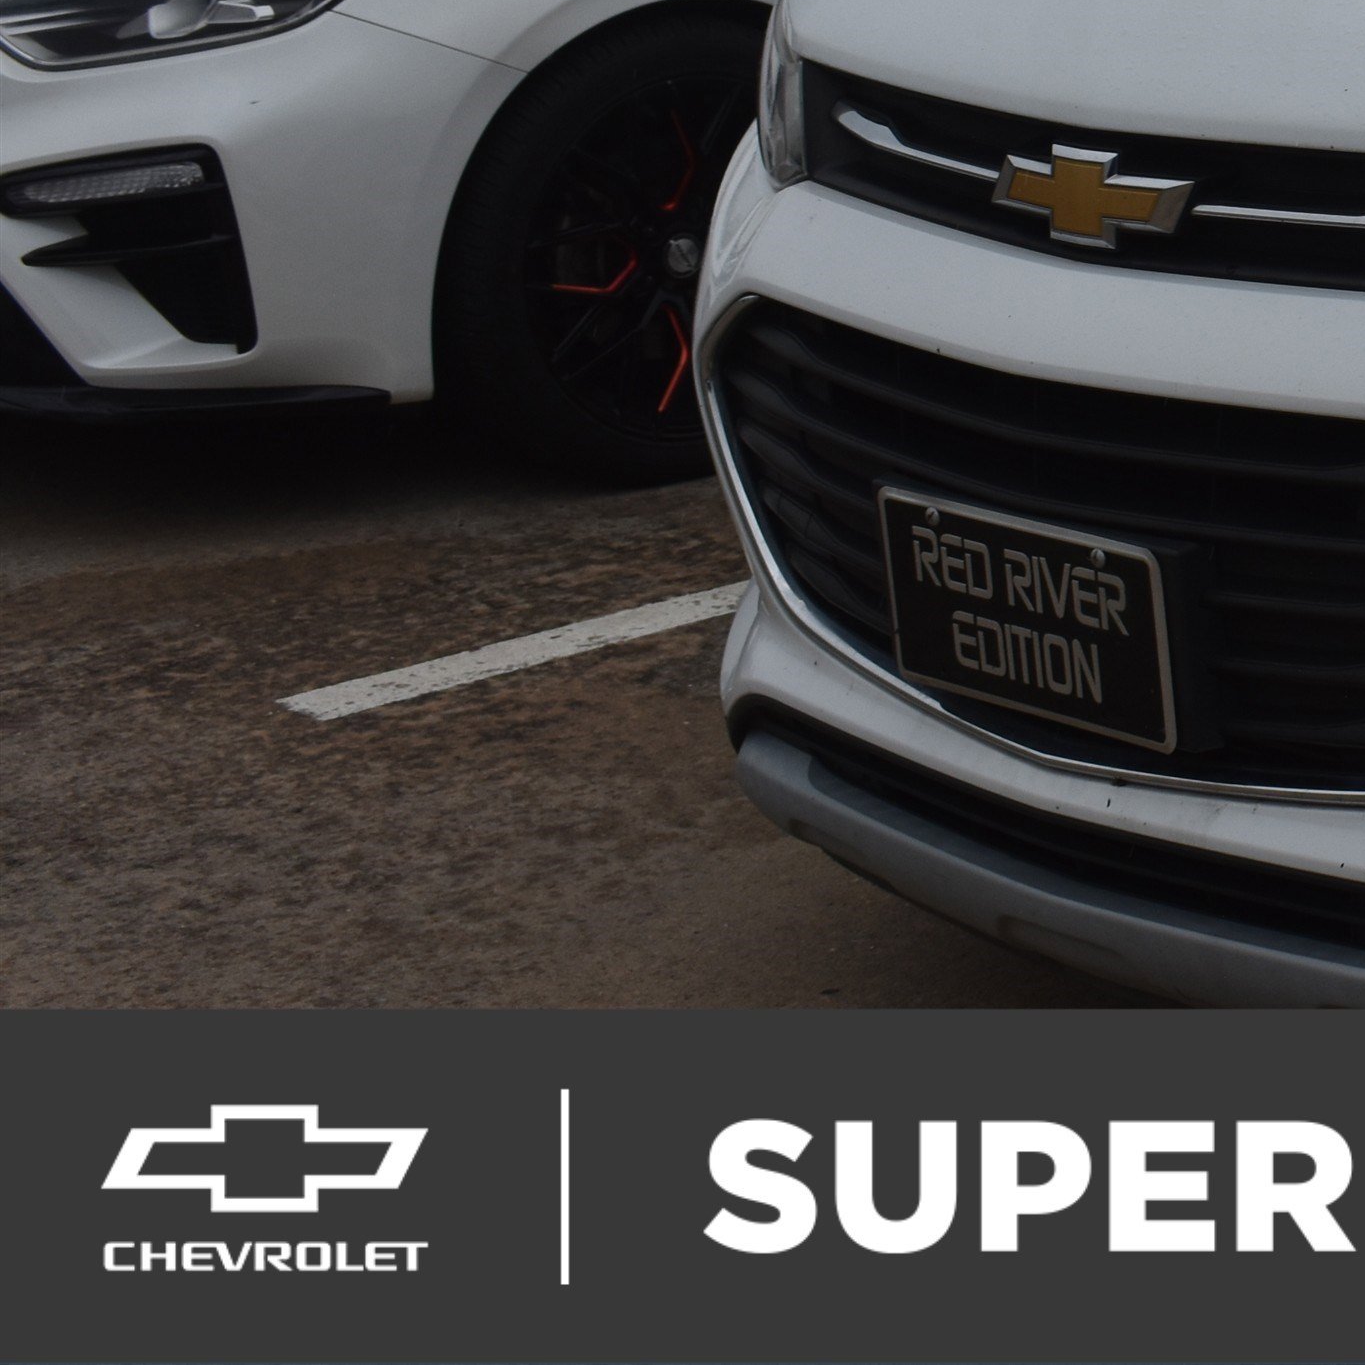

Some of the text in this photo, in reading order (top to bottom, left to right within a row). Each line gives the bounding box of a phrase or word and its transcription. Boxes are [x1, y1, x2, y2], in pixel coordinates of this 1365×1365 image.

[912, 526, 1130, 636] RED RIVER
[952, 610, 1102, 704] EDITION
